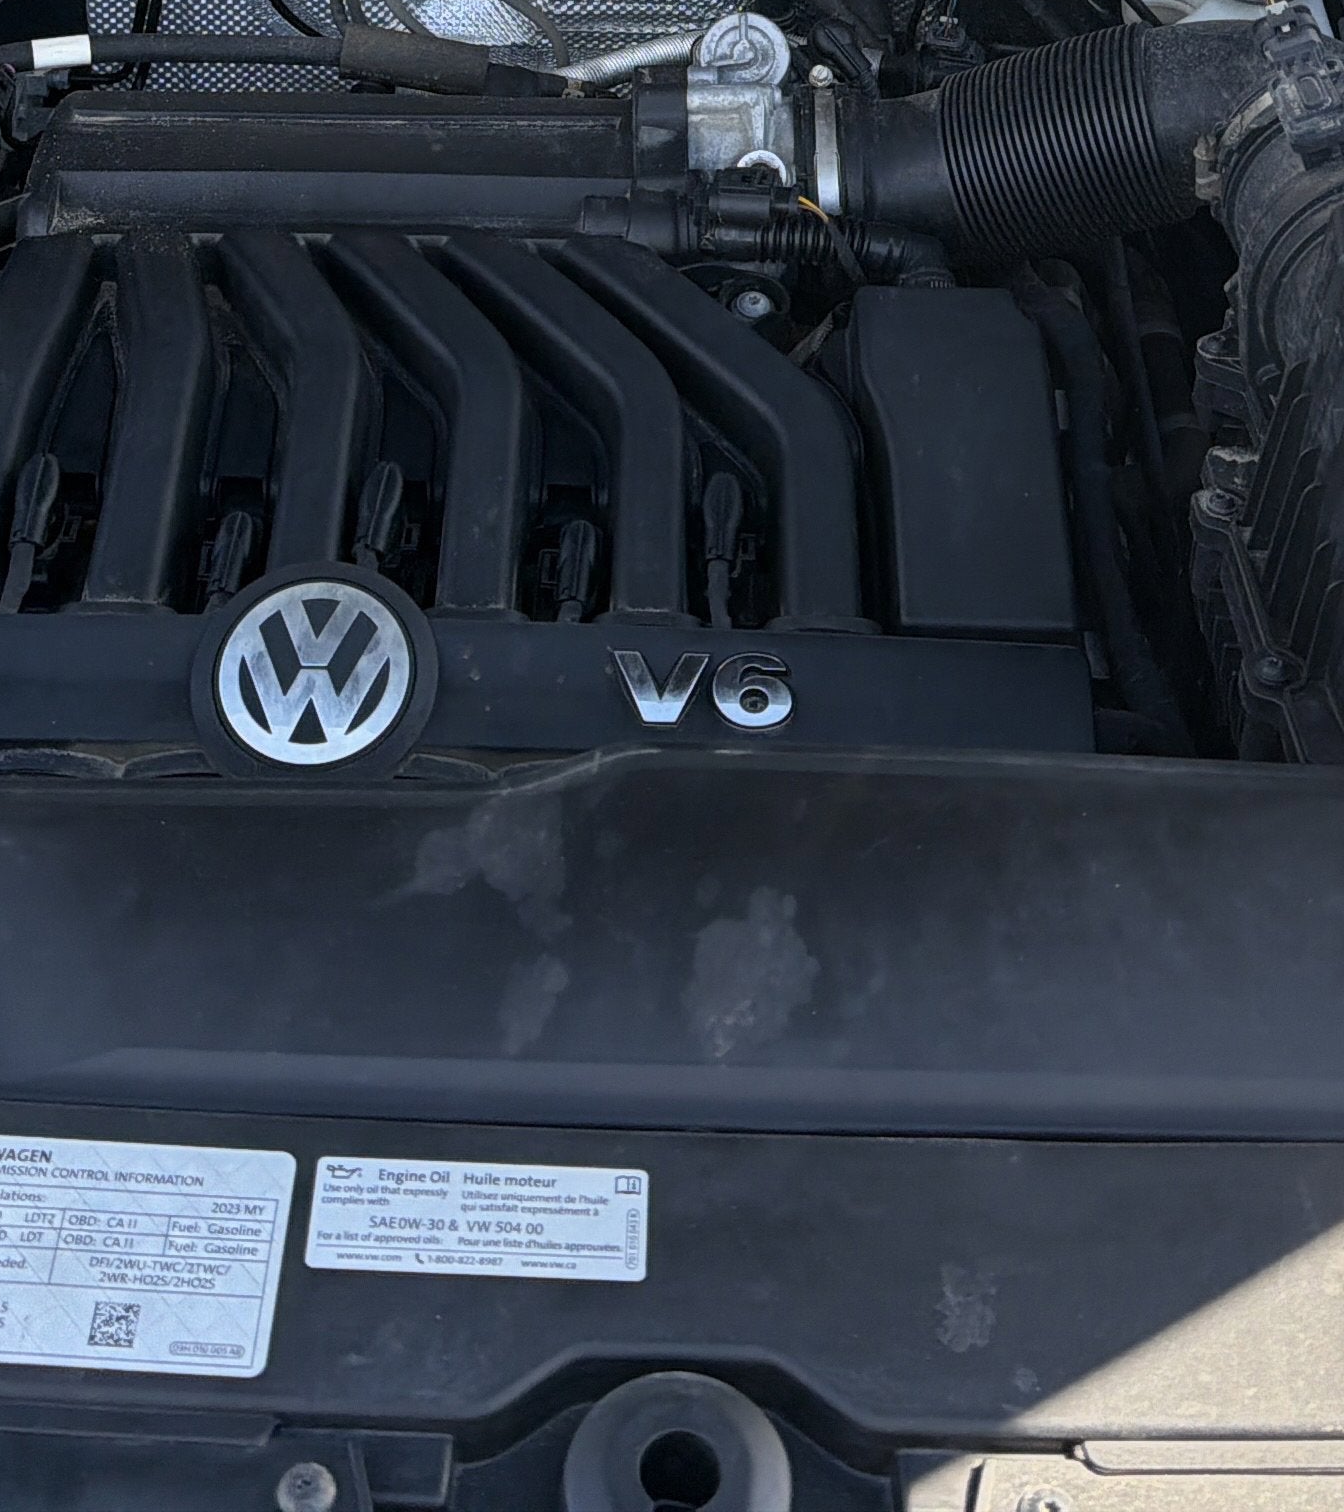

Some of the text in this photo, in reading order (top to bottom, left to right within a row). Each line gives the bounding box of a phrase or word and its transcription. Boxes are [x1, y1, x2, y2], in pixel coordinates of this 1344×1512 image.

[611, 649, 795, 731] V6
[51, 1167, 110, 1181] CONTROL
[114, 1171, 204, 1186] INFORMATION
[378, 1168, 557, 1188] Engine Oil Huile moteur
[323, 1183, 448, 1199] Use only oil that expressly
[462, 1190, 609, 1206] Utilisez uniquement de l'huile
[321, 1194, 389, 1206] complies with
[461, 1202, 477, 1213] qui
[479, 1203, 519, 1213] satisfait
[211, 1201, 265, 1216] 2023 MY
[68, 1214, 100, 1227] OBD:
[107, 1216, 125, 1228] CA
[171, 1220, 200, 1234] Fuel:
[207, 1222, 262, 1237] Gasoline
[448, 1219, 459, 1232] &
[466, 1220, 491, 1233] VW
[494, 1221, 522, 1234] 504
[525, 1223, 544, 1235] 00
[20, 1231, 44, 1243] LDT
[63, 1233, 96, 1246] OBD:
[102, 1236, 121, 1248] CA
[167, 1239, 197, 1253] Fuel:
[204, 1242, 259, 1257] Gasoline
[317, 1230, 333, 1240] For
[343, 1231, 359, 1241] list
[361, 1232, 372, 1241] of
[373, 1234, 421, 1246] approved
[458, 1236, 480, 1246] Pour
[483, 1238, 501, 1247] une
[503, 1238, 523, 1248] liste
[336, 1251, 402, 1262] www.vw.com
[521, 1259, 577, 1270] www.vw.ca
